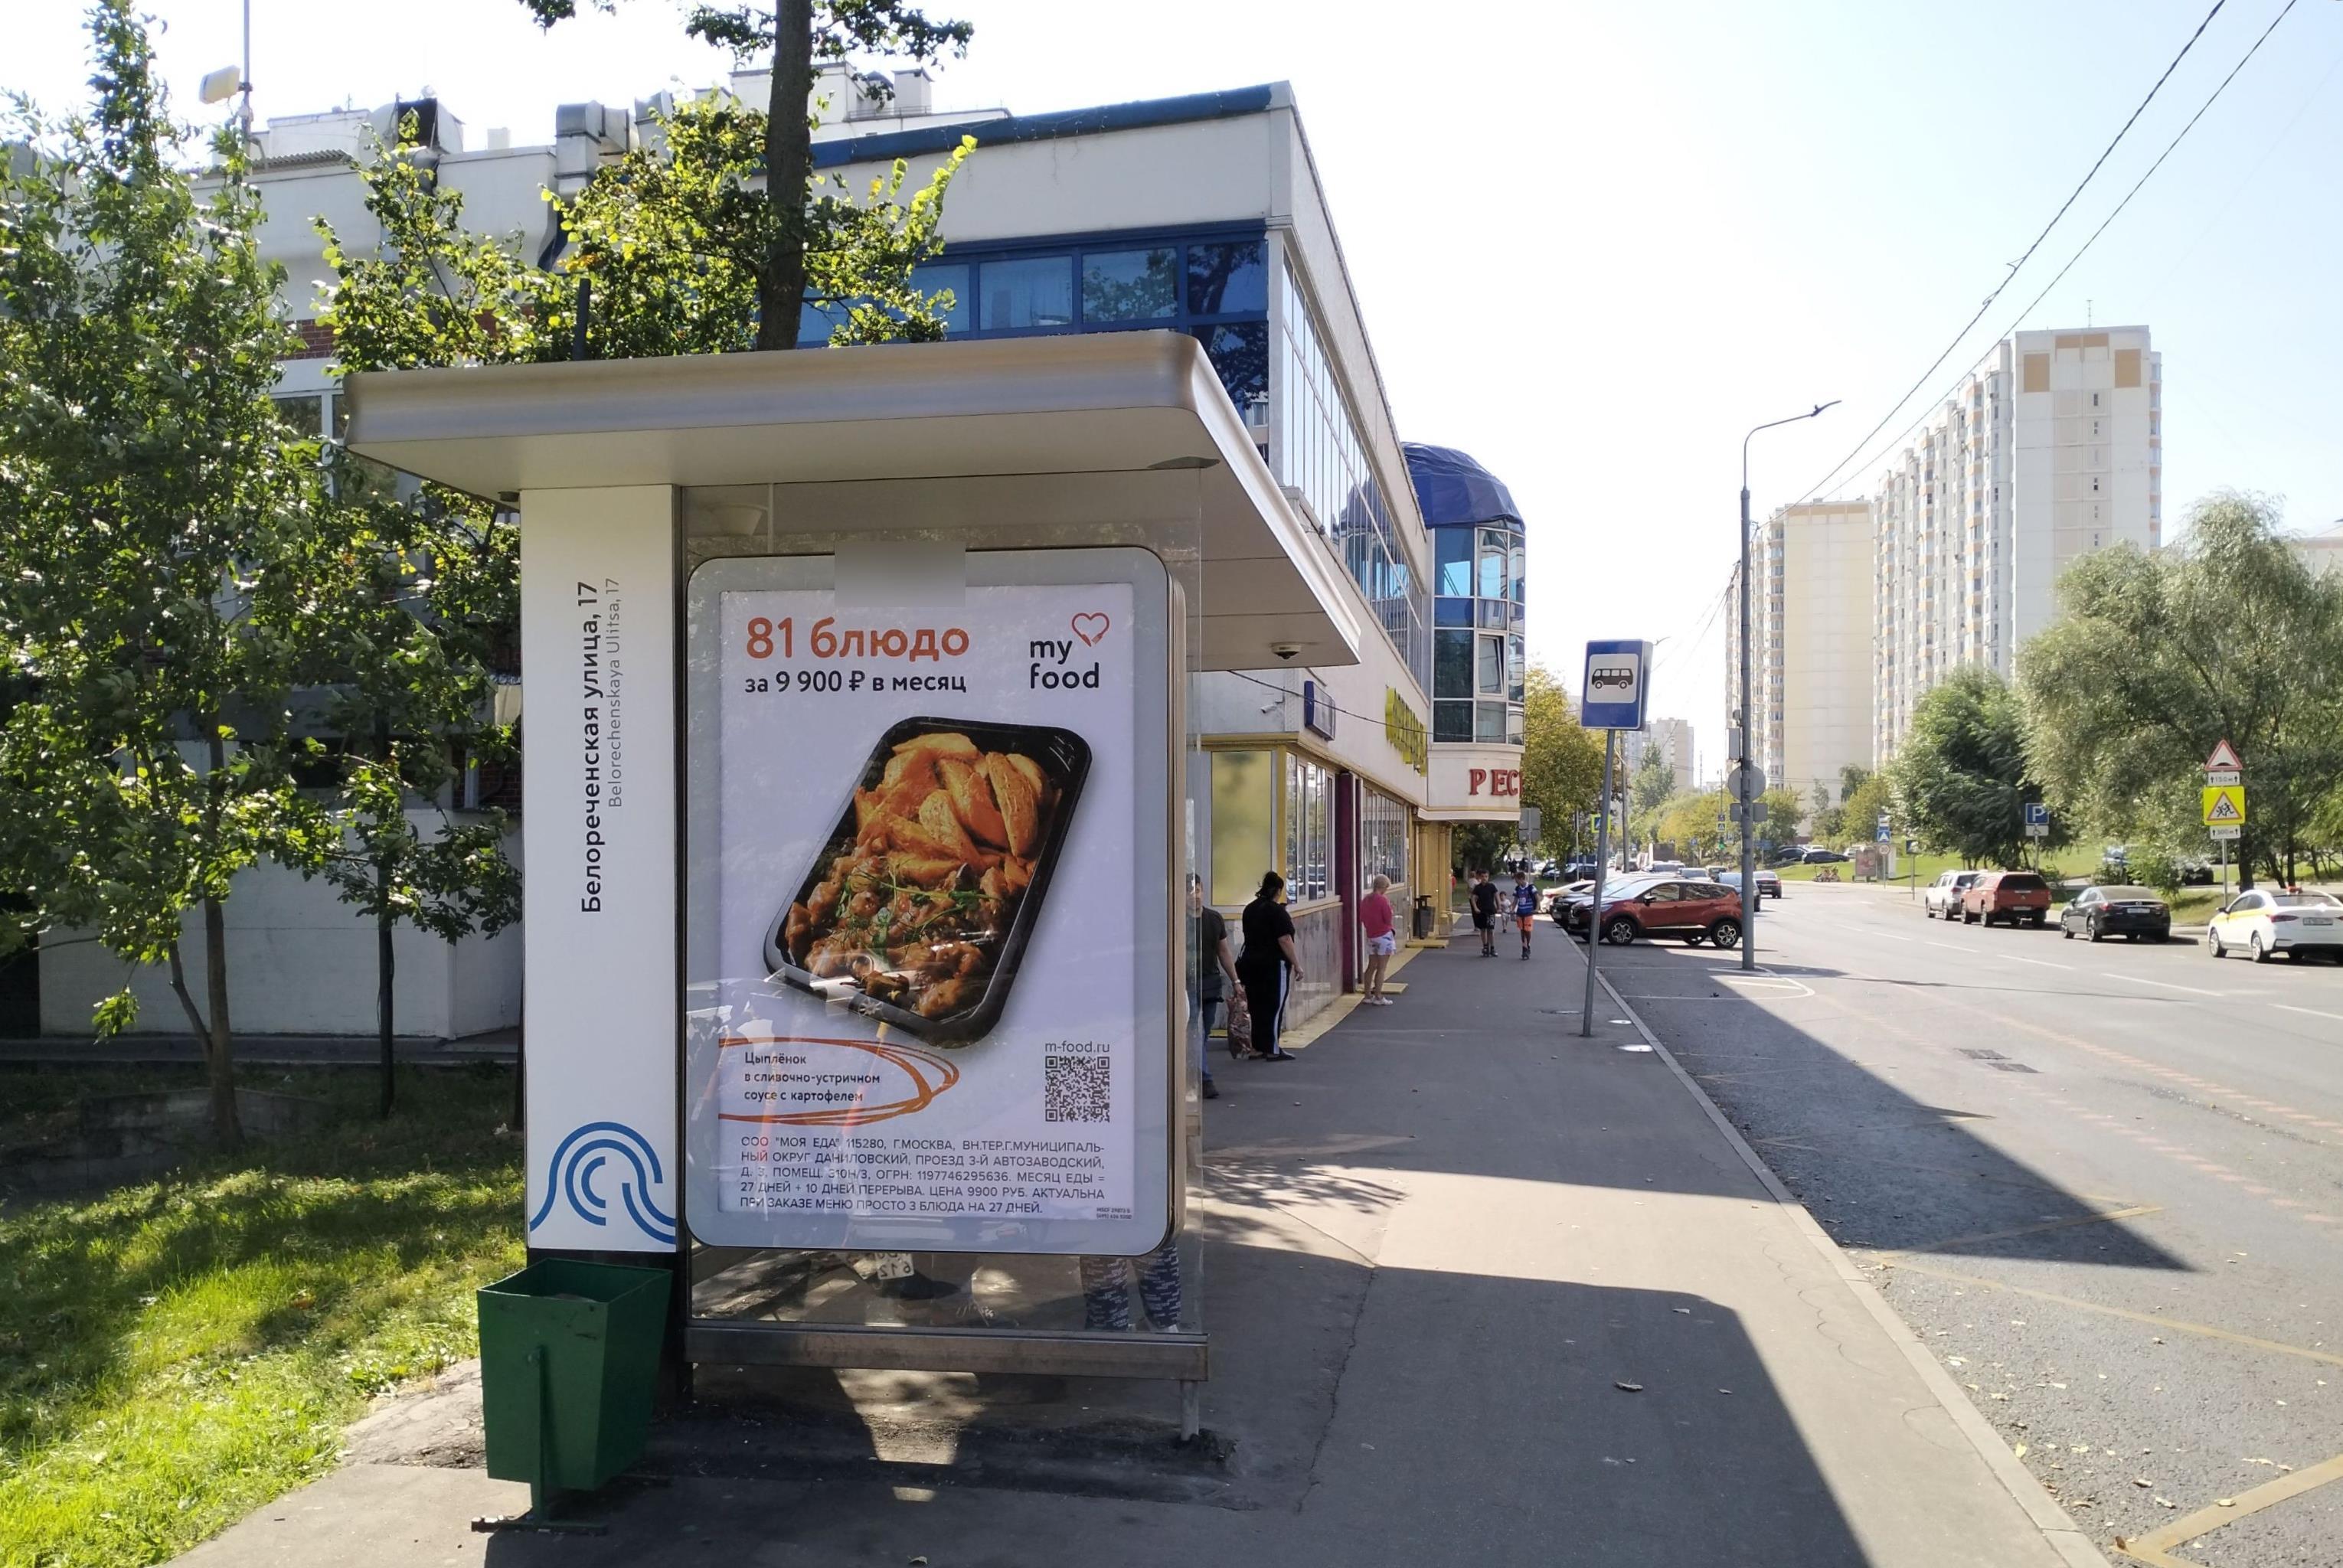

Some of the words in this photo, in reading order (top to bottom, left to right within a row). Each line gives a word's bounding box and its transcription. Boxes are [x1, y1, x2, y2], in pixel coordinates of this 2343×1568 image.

[577, 582, 597, 606] 17
[606, 578, 619, 594] 17
[606, 599, 622, 653] Ulitsa,
[747, 617, 792, 658] 81
[811, 616, 969, 662] блюдо
[583, 614, 603, 699] улица,
[1030, 640, 1073, 665] my
[745, 678, 768, 693] за
[872, 677, 884, 691] в
[892, 676, 966, 693] месяц
[1031, 662, 1100, 689] food
[606, 660, 623, 807] Belorechenskaya
[581, 707, 606, 912] Белореченская
[1045, 1040, 1109, 1053] m-food.ru
[745, 1051, 806, 1064] Цыплёнок
[745, 1073, 750, 1082] в
[754, 1073, 880, 1086] сливочно-устричном
[744, 1091, 777, 1102] соусе
[780, 1092, 786, 1100] с
[791, 1089, 862, 1104] картофелем
[741, 1136, 769, 1146] ООО
[776, 1137, 806, 1147] "МОЯ
[846, 1138, 887, 1150] 115280,
[894, 1139, 956, 1151] Г.МОСКВА,
[741, 1150, 767, 1162] НЫЙ
[773, 1152, 811, 1162] ОКРУГ
[815, 1152, 910, 1165] ДАНИЛОВСКИЙ,
[916, 1155, 964, 1167] ПРОЕЗД
[969, 1154, 989, 1166] 3-Й
[993, 1156, 1104, 1169] АВТОЗАВОДСКИЙ,
[740, 1167, 752, 1178] Д.
[773, 1167, 823, 1179] ПОМЕЩ.
[876, 1170, 912, 1180] ОГРН:
[1017, 1171, 1060, 1184] МЕСЯЦ
[1066, 1173, 1093, 1184] ЕДЫ
[740, 1182, 754, 1191] 27
[758, 1181, 790, 1194] ДНЕЙ
[806, 1184, 817, 1193] 10
[822, 1182, 854, 1194] ДНЕЙ
[859, 1184, 925, 1195] ПЕРЕРЫВА.
[930, 1186, 963, 1197] ЦЕНА
[967, 1187, 998, 1197] 9900
[1002, 1187, 1028, 1197] РУБ.
[1032, 1187, 1105, 1199] АКТУАЛЬНА
[740, 1197, 763, 1207] ПРИ
[767, 1197, 812, 1208] ЗАКАЗЕ
[815, 1199, 852, 1209] МЕНЮ
[857, 1200, 906, 1210] ПРОСТО
[909, 1201, 916, 1210] 3
[920, 1201, 965, 1212] БЛЮДА
[969, 1202, 985, 1211] НА
[989, 1202, 1002, 1212] 27
[1005, 1201, 1043, 1214] ДНЕЙ.
